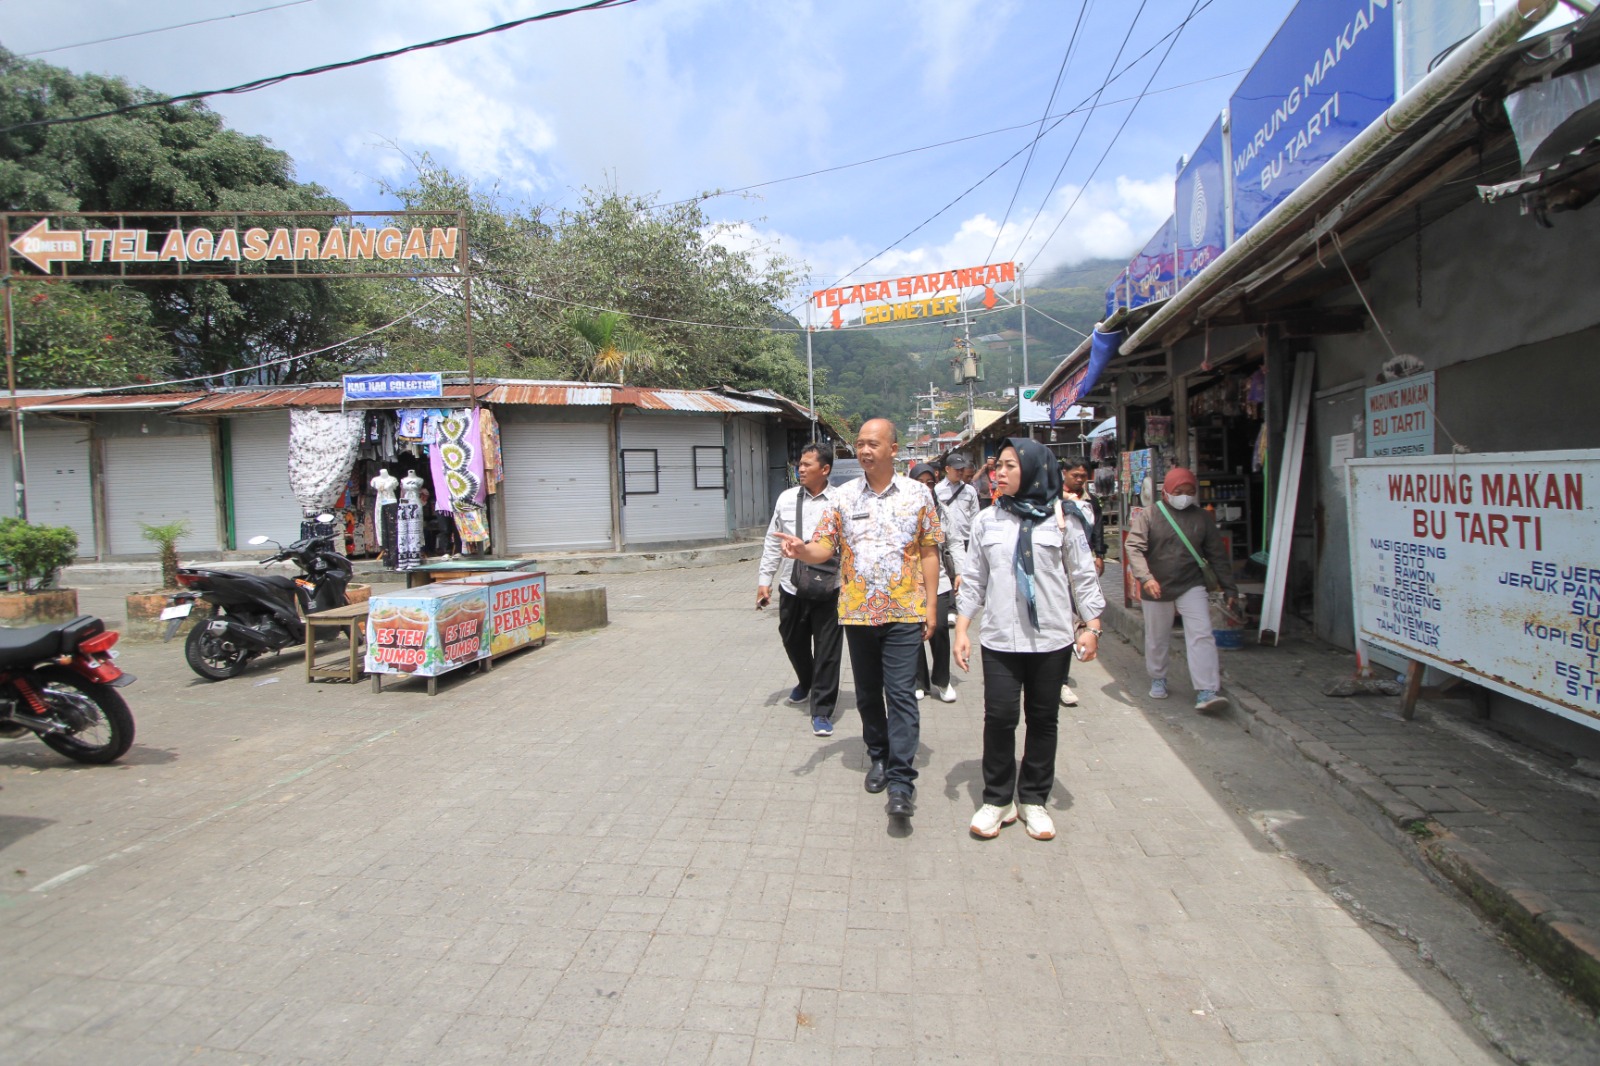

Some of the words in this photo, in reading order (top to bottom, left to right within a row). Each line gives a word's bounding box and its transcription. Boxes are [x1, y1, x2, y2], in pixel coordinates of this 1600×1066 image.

[1234, 86, 1301, 176] WARUNG
[1261, 151, 1283, 191] BU
[1285, 92, 1339, 163] TARTI
[1139, 263, 1161, 293] TOKO
[813, 286, 892, 308] TELAGA
[864, 304, 892, 325] 20
[893, 295, 959, 321] METER
[1370, 390, 1399, 413] WARUNG
[1400, 383, 1429, 407] MAKAN
[1373, 417, 1388, 437] BU
[1390, 410, 1426, 433] TARTI
[1373, 449, 1390, 457] NASI
[1391, 443, 1425, 455] GORENG
[1388, 473, 1473, 505] WARUNG
[1481, 473, 1584, 511] MAKAN
[1413, 509, 1447, 540] BU
[1454, 511, 1543, 552] TARTI
[1370, 537, 1394, 552] NASI
[1393, 541, 1447, 560] GORENG
[1394, 553, 1425, 569] SOTO
[1531, 560, 1557, 577] ES
[1395, 566, 1436, 584] RAWON
[1498, 571, 1558, 594] JERUK
[492, 583, 542, 612] JERUK
[1373, 584, 1391, 598] MIE
[1391, 588, 1442, 611] GORENG
[1395, 578, 1435, 597] PECEL
[493, 603, 541, 635] PERAS
[1392, 600, 1422, 618] KUAH
[445, 624, 459, 643] ES
[458, 619, 478, 640] TEH
[1376, 618, 1402, 635] TAHU
[1402, 627, 1441, 651] TELUR
[1393, 612, 1441, 637] NYEMEK
[1524, 621, 1567, 645] KOPI
[376, 628, 395, 644] ES
[396, 628, 425, 647] TEH
[444, 636, 480, 662] JUMBO
[374, 646, 427, 665] JUMBO
[1555, 660, 1581, 681] ES
